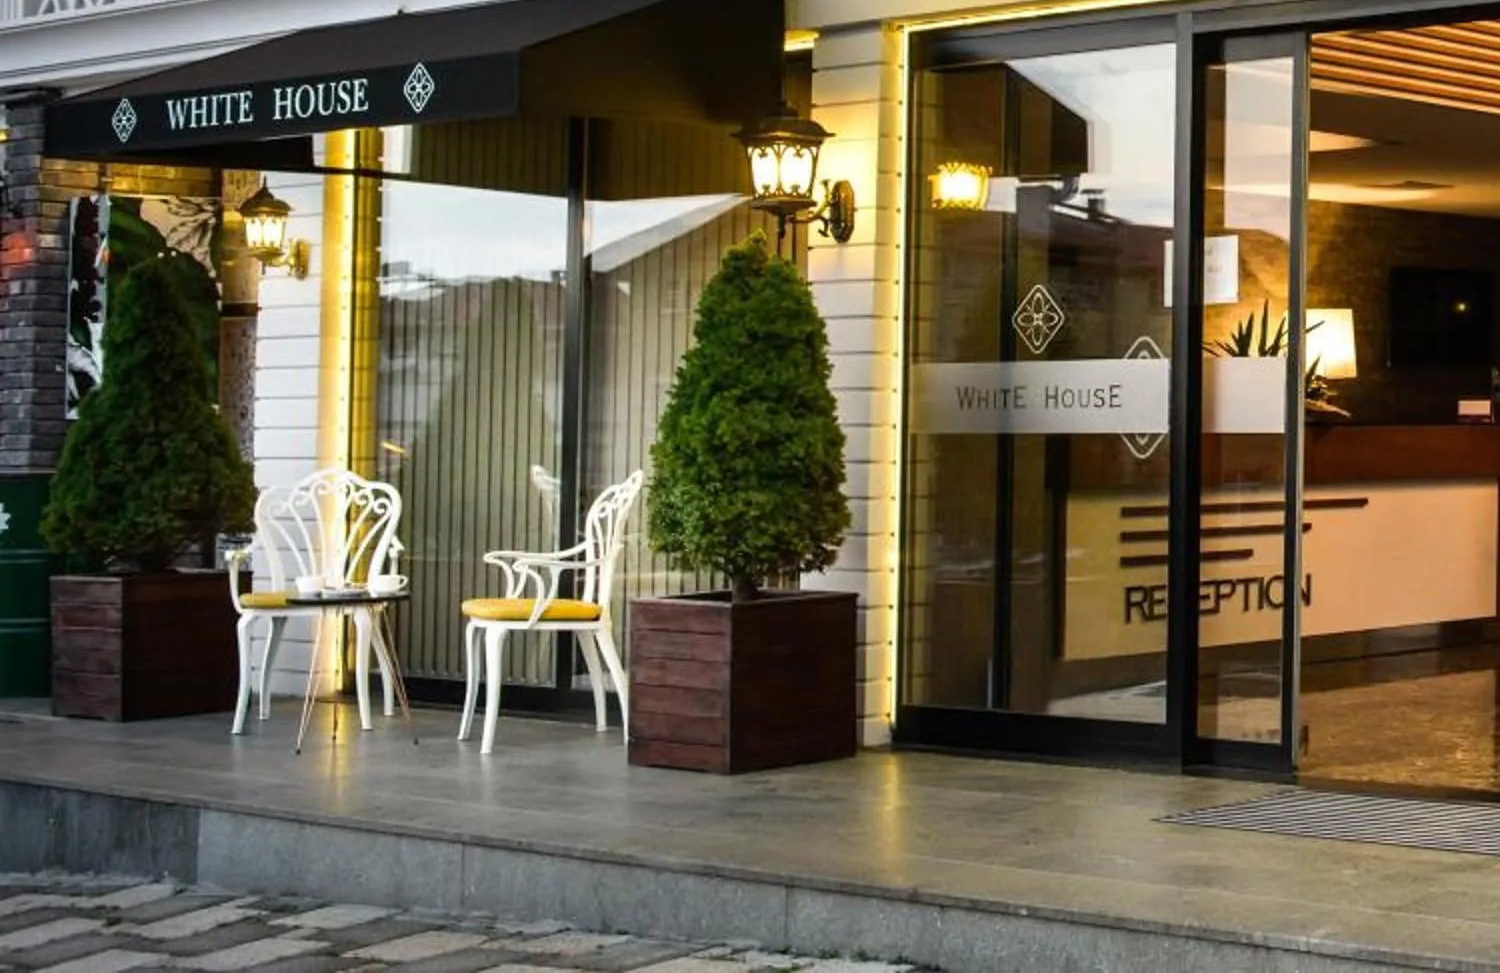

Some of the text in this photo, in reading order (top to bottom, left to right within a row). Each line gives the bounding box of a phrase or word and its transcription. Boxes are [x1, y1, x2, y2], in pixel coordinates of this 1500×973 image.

[166, 78, 370, 130] WHITE HOUSE
[956, 383, 1123, 410] WHITE HOUSE
[1124, 574, 1313, 625] REEPTION
